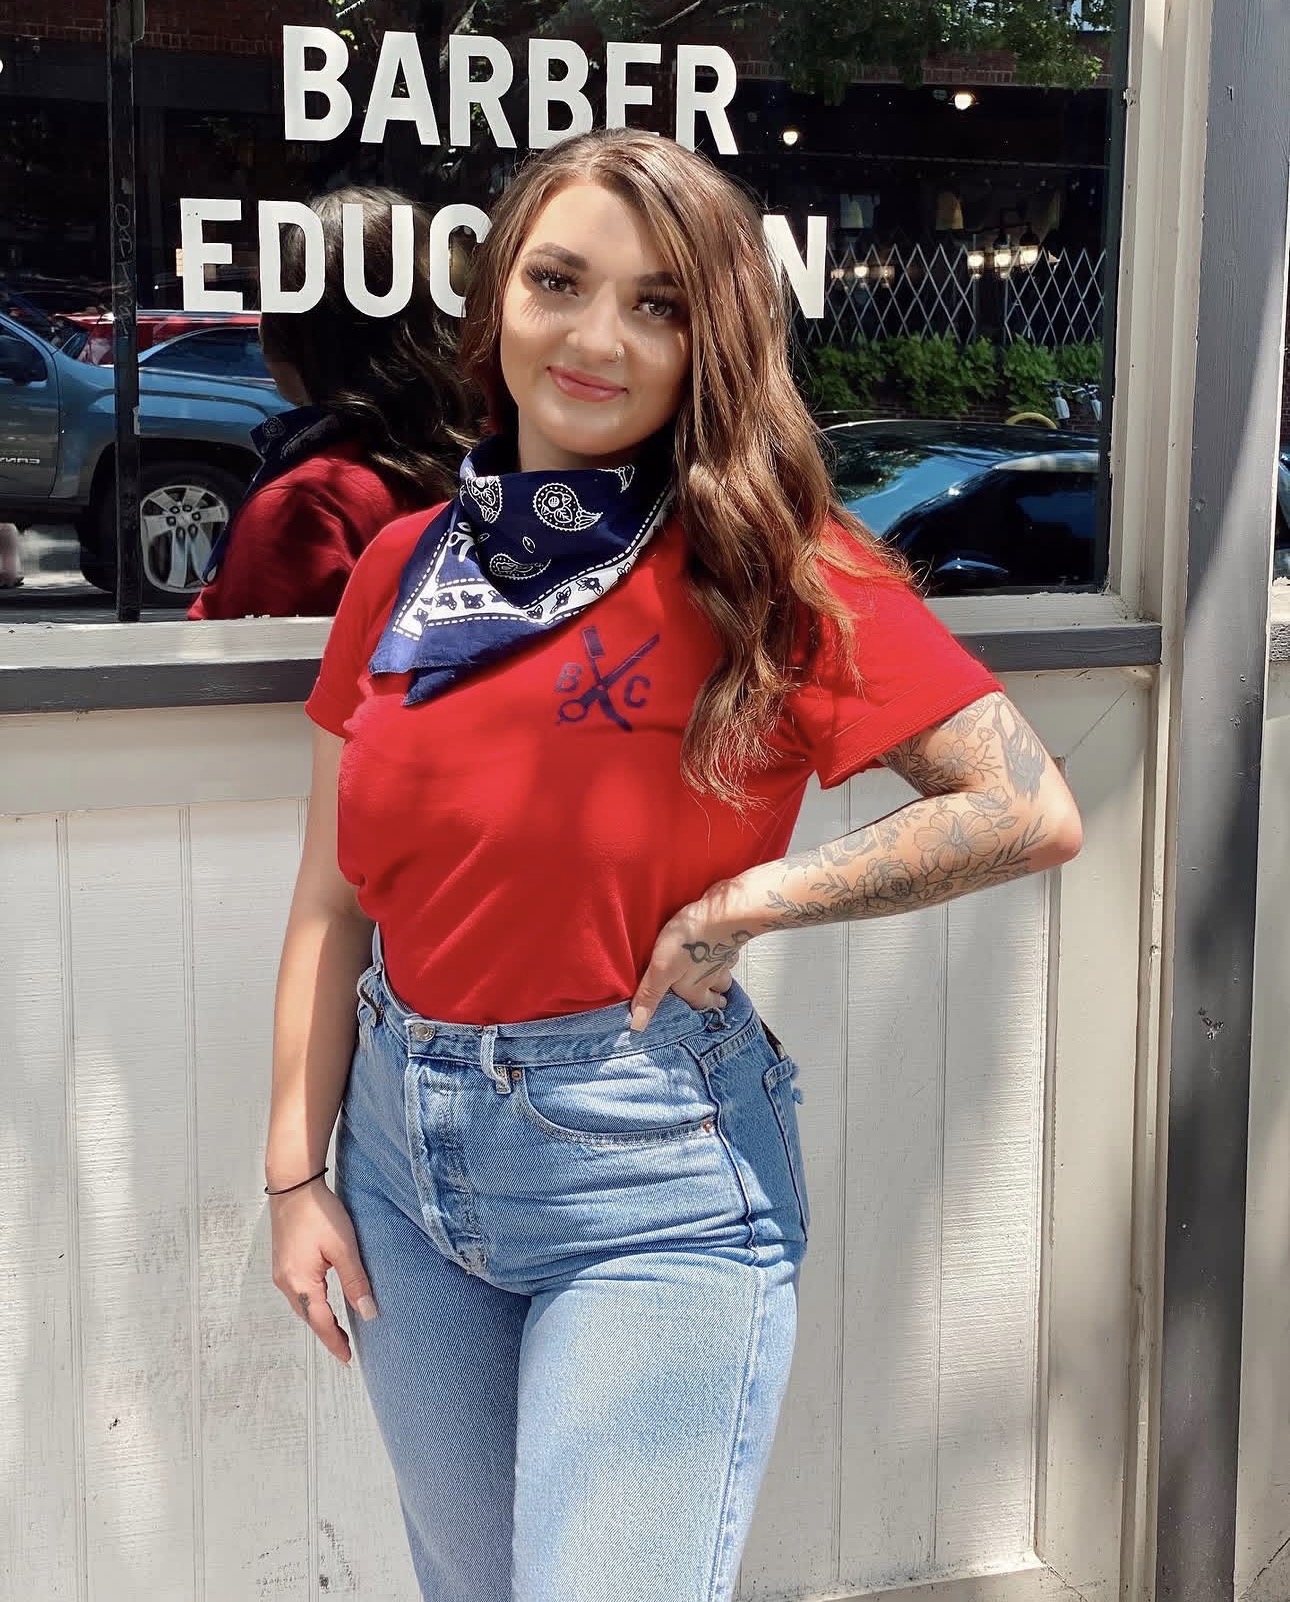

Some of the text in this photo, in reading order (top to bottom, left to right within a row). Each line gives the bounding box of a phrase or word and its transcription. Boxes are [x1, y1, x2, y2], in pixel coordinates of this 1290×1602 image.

[282, 25, 739, 155] BARBER
[179, 198, 828, 319] EDUCN
[556, 662, 651, 708] B C
